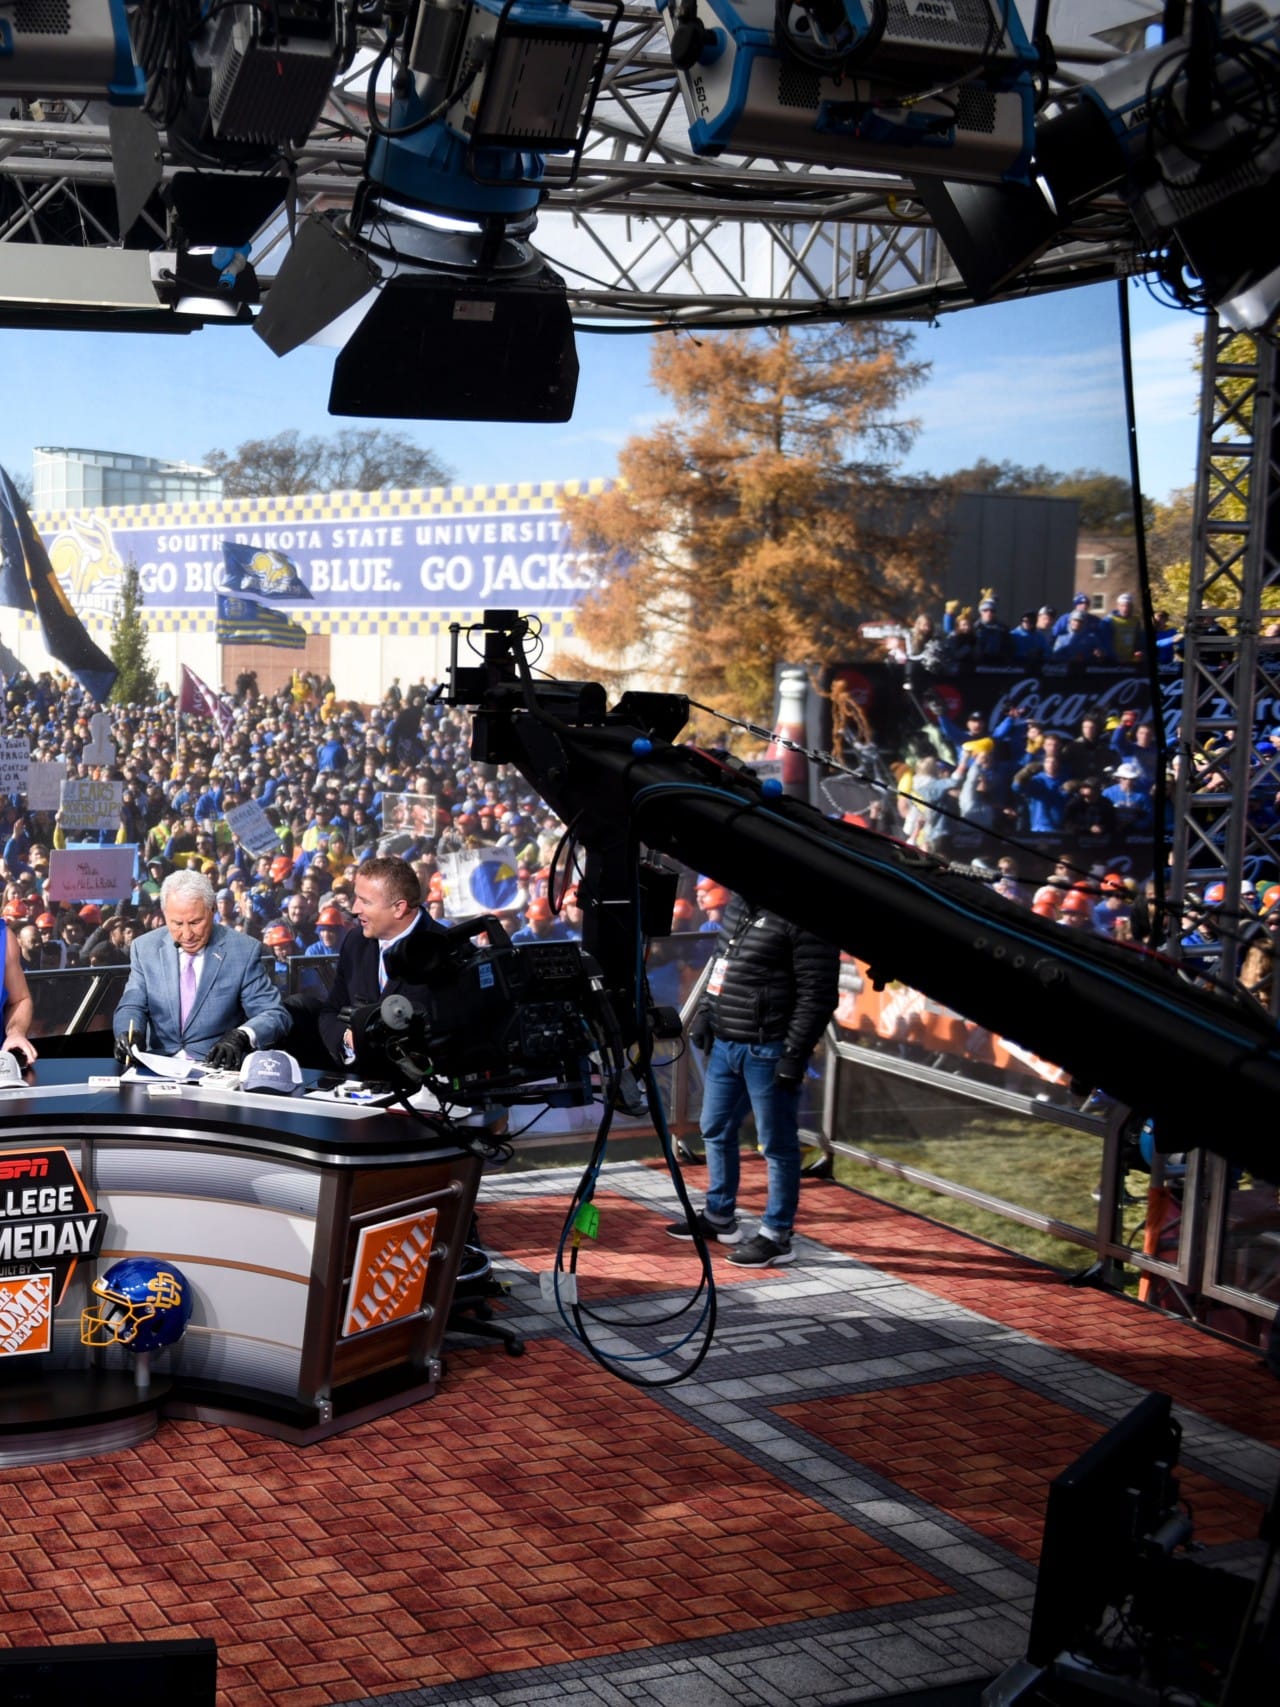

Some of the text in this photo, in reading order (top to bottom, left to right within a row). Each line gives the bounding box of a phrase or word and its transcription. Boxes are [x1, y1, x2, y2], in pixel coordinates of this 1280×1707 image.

[157, 532, 223, 553] SOUTH
[331, 526, 403, 548] STATE
[415, 519, 575, 546] UNIVERSIT
[138, 562, 179, 594] GO
[310, 557, 402, 593] BLUE.
[419, 555, 473, 592] GO
[0, 751, 30, 761] FARGO
[78, 782, 114, 801] EARS
[18, 1263, 34, 1276] BY
[350, 1214, 435, 1329] HOME
[367, 1235, 401, 1279] THE
[0, 1302, 51, 1355] DEPOT
[655, 1309, 898, 1362] ESPN
